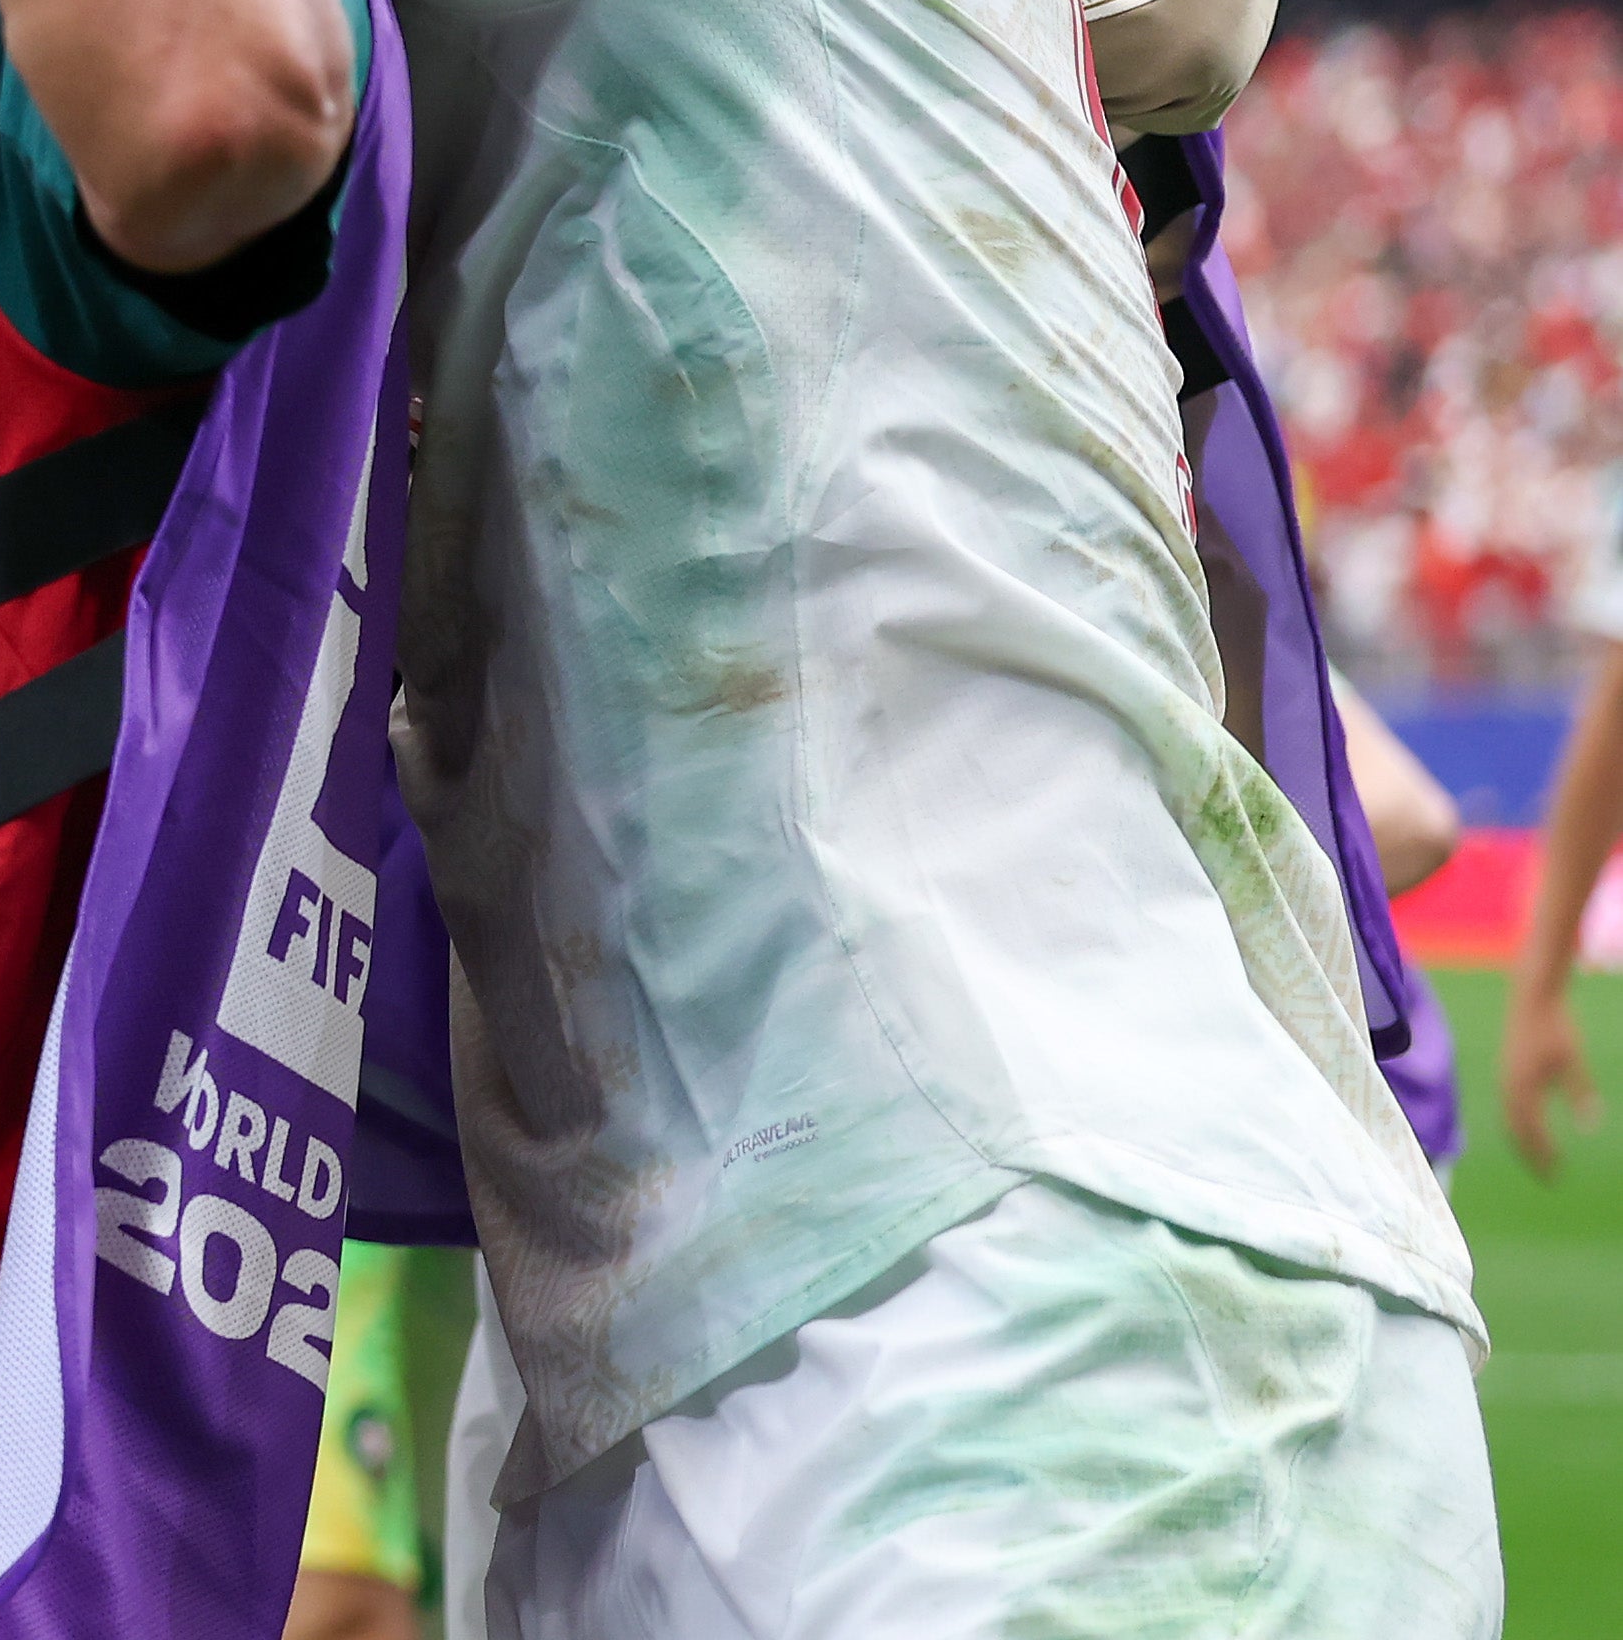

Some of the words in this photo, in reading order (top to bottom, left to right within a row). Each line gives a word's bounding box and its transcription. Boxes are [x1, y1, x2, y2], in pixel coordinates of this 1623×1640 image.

[267, 867, 372, 1006] FIF
[154, 1029, 343, 1221] WORLD
[95, 1138, 341, 1397] 202
